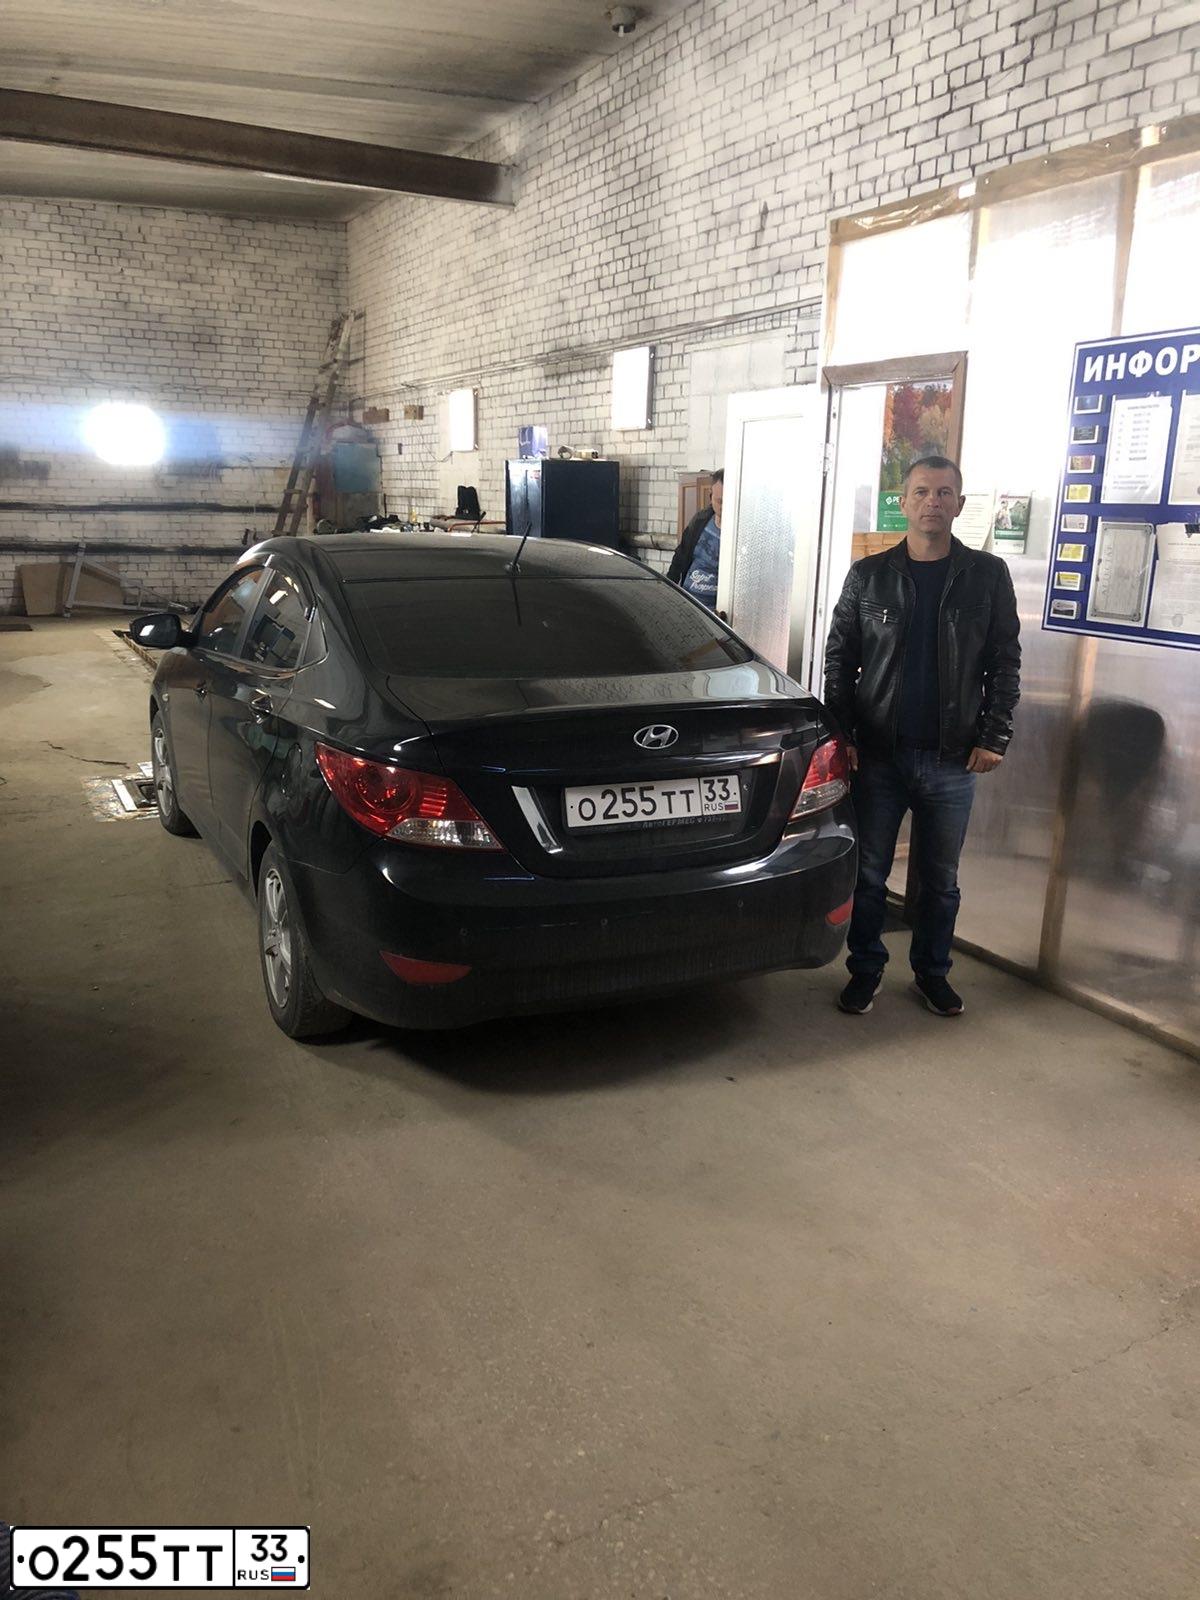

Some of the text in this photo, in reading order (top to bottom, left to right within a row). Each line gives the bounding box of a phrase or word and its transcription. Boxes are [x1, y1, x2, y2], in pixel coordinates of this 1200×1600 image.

[1083, 344, 1200, 383] ИНФОР
[578, 778, 731, 821] О255ТТ 33
[704, 803, 724, 812] RUS
